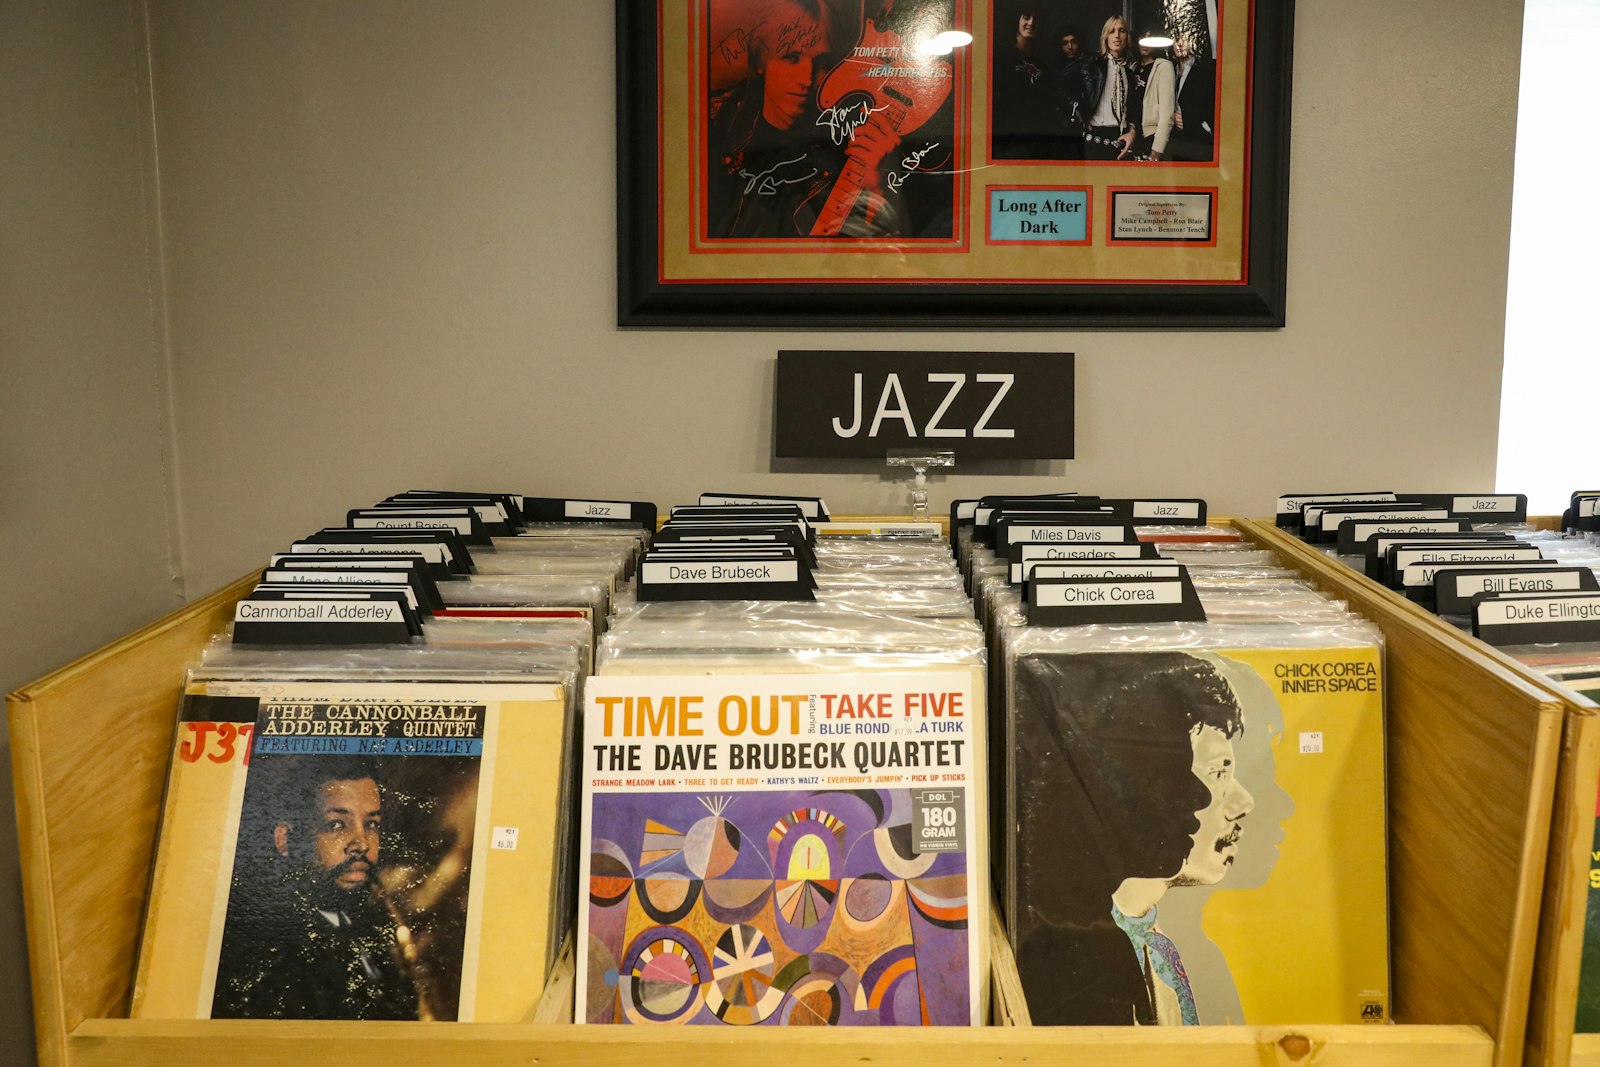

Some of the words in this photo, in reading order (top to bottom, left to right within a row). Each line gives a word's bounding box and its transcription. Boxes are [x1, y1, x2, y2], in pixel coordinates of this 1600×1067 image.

[853, 47, 875, 57] TOM
[999, 199, 1038, 215] Long
[1041, 199, 1082, 213] After
[1162, 209, 1177, 217] Petty
[1020, 220, 1059, 234] Dark
[1138, 217, 1168, 225] Campbell
[1133, 226, 1153, 234] Lynch
[832, 372, 1015, 438] JAZZ
[584, 505, 611, 516] Jazz
[1153, 505, 1179, 516] Jazz
[1472, 499, 1497, 510] Jazz
[1031, 528, 1063, 541] Miles
[1067, 528, 1101, 541] Davis
[1046, 548, 1116, 559] Crusaders
[669, 566, 707, 579] Dave
[711, 564, 771, 579] Brubeck
[1483, 578, 1504, 592] Bill
[1509, 577, 1553, 591] Evans
[1064, 587, 1106, 602] Chick
[1110, 586, 1155, 601] Corea
[240, 604, 323, 619] Cannonball
[327, 604, 393, 621] Adderley
[1506, 605, 1544, 619] Duke
[1274, 663, 1321, 678] CHICK
[1322, 662, 1377, 677] COREA
[1282, 679, 1326, 693] INNER
[1328, 677, 1377, 692] SPACE
[267, 704, 314, 720] THE
[326, 704, 477, 720] CANNONBALL
[820, 694, 893, 719] TAKE
[904, 692, 964, 718] FIVE
[595, 696, 704, 737] TIME
[718, 695, 809, 737] OUT
[807, 694, 817, 734] Featuring
[262, 720, 390, 736] ADDERLEY
[403, 721, 476, 737] QUINTET
[820, 723, 851, 735] BLUE
[855, 722, 892, 734] ROND
[931, 721, 964, 733] TURK
[260, 738, 348, 751] FEATURING
[393, 740, 473, 754] ADDERLEY
[593, 745, 642, 771] THE
[655, 744, 717, 771] DAVE
[729, 742, 846, 771] BRUBECK
[853, 740, 965, 774] QUARTET
[592, 779, 623, 787] STRANGE
[626, 779, 655, 787] MEADOW
[684, 778, 706, 786] THREE
[709, 778, 718, 786] TO
[767, 777, 795, 785] KATHY'S
[827, 776, 872, 784] EVERYBODY'S
[911, 774, 927, 782] PICK
[930, 774, 939, 782] UP
[942, 773, 966, 782] STICKS
[928, 793, 947, 801] DOL
[921, 806, 957, 827] 180
[921, 826, 956, 838] GRAM
